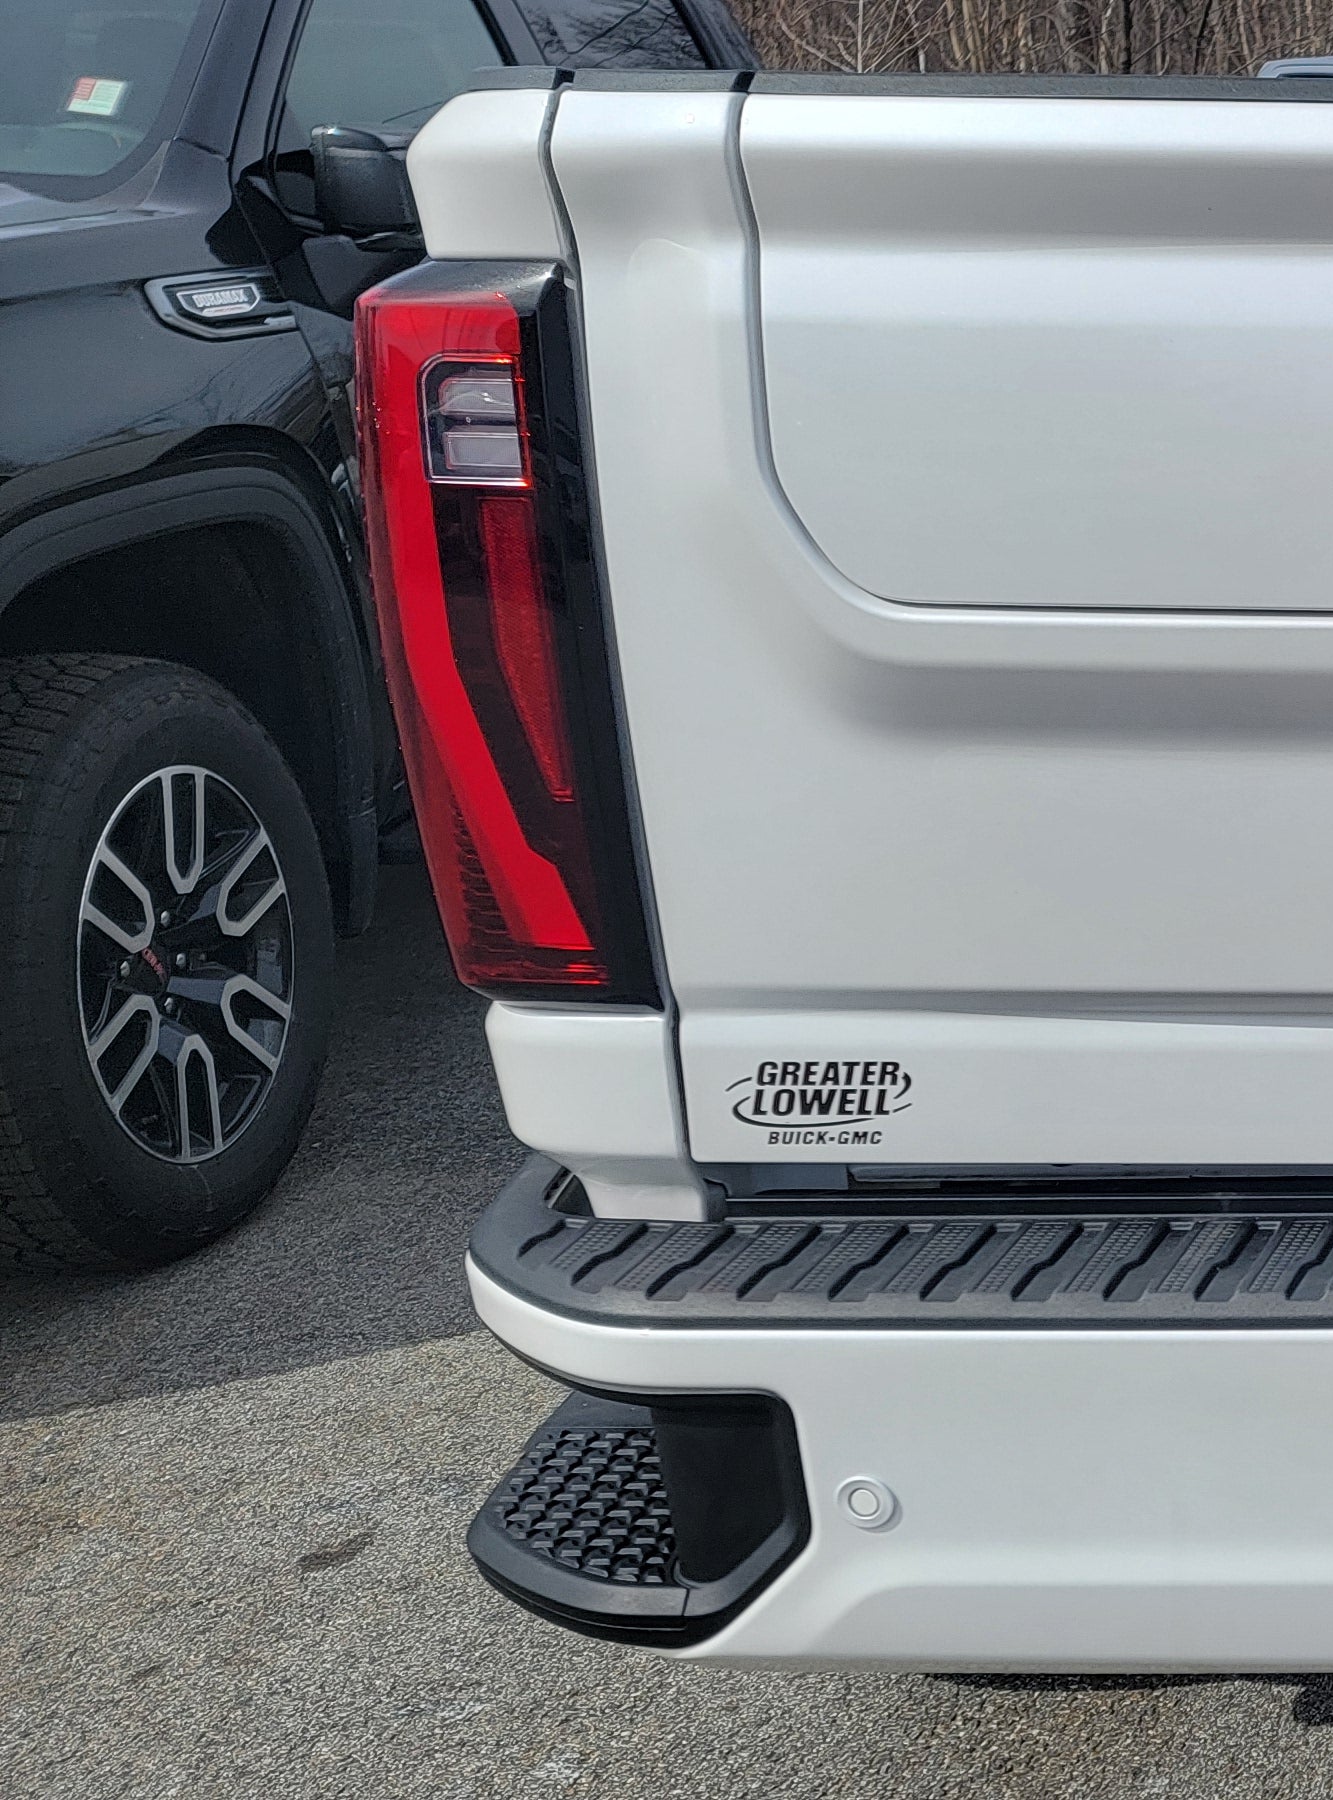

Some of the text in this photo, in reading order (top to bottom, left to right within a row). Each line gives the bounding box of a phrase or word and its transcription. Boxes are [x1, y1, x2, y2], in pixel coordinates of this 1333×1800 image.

[757, 1061, 900, 1086] GREATER
[752, 1088, 890, 1116] LOWELL
[768, 1131, 883, 1145] BUICK-GMC
